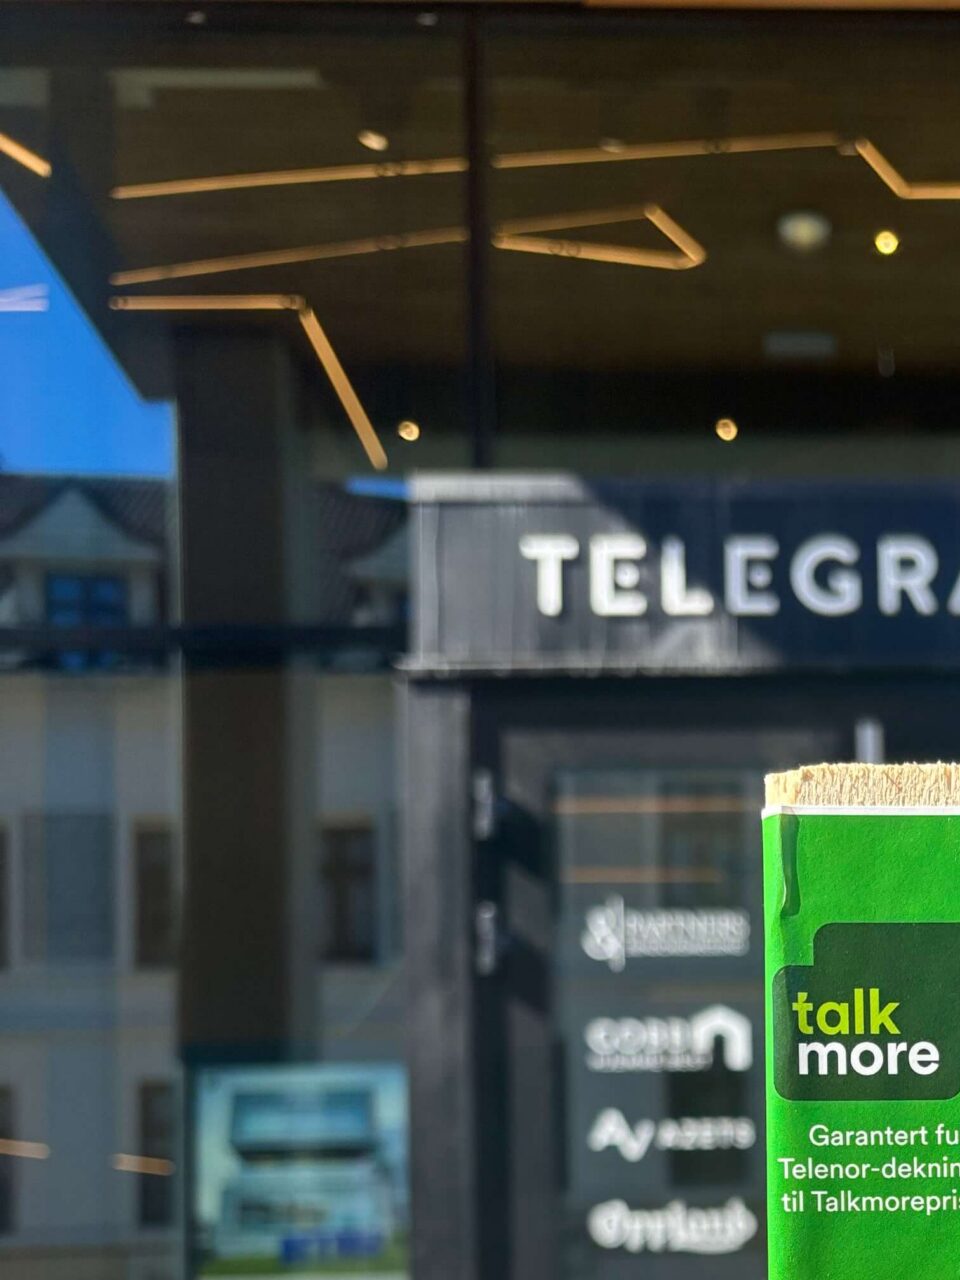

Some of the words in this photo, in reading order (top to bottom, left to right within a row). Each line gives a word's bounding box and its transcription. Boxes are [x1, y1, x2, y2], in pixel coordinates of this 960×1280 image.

[792, 988, 901, 1035] talk
[798, 1041, 940, 1076] more
[808, 1124, 928, 1146] Garantert
[781, 1190, 805, 1212] til
